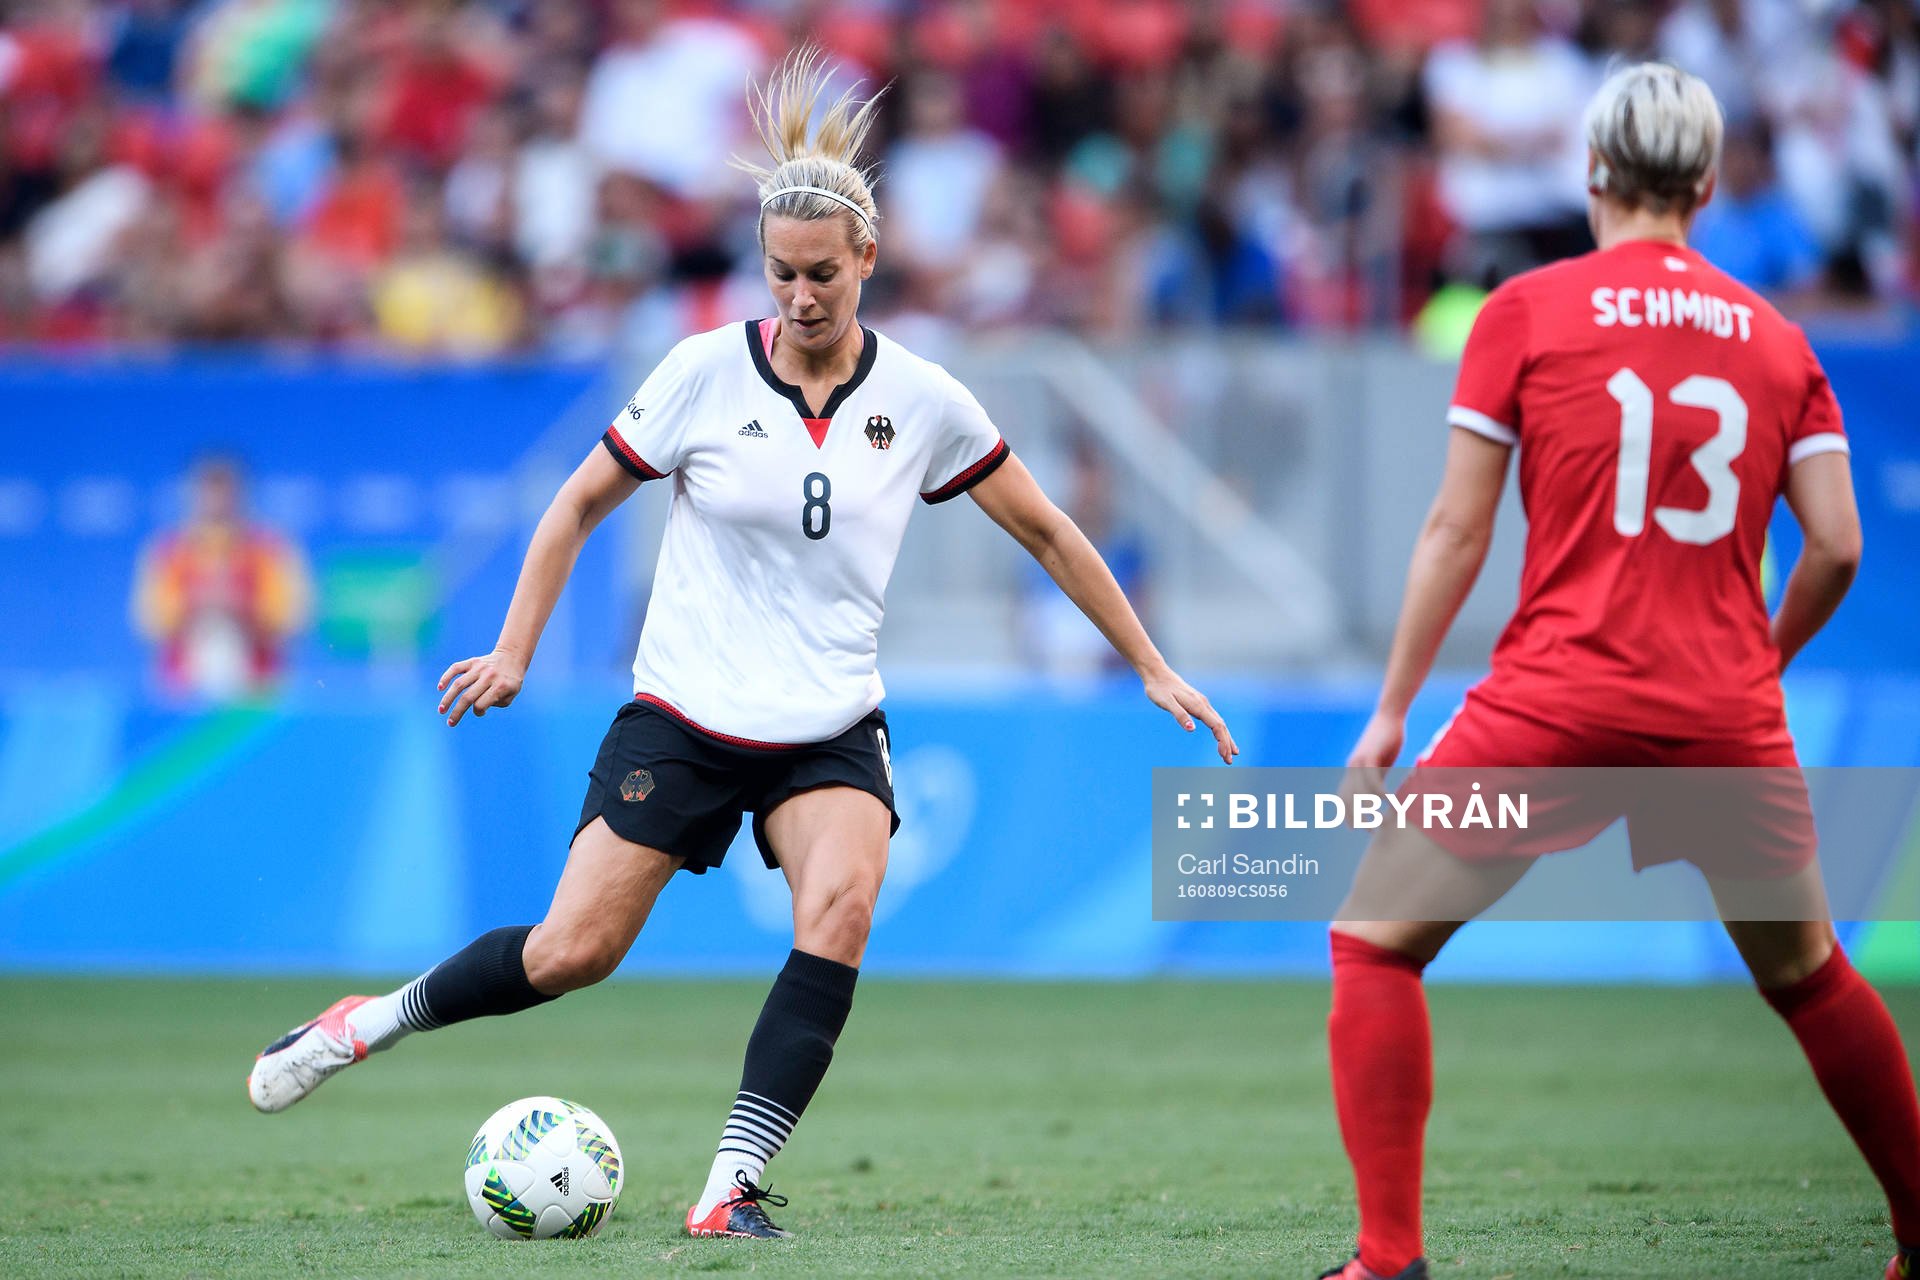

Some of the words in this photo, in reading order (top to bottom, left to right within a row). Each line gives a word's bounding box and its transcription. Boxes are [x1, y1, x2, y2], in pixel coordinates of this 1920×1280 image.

[1591, 287, 1753, 342] SCHMIDT
[738, 429, 769, 438] adidas
[1606, 367, 1749, 546] 13
[802, 472, 831, 540] 8
